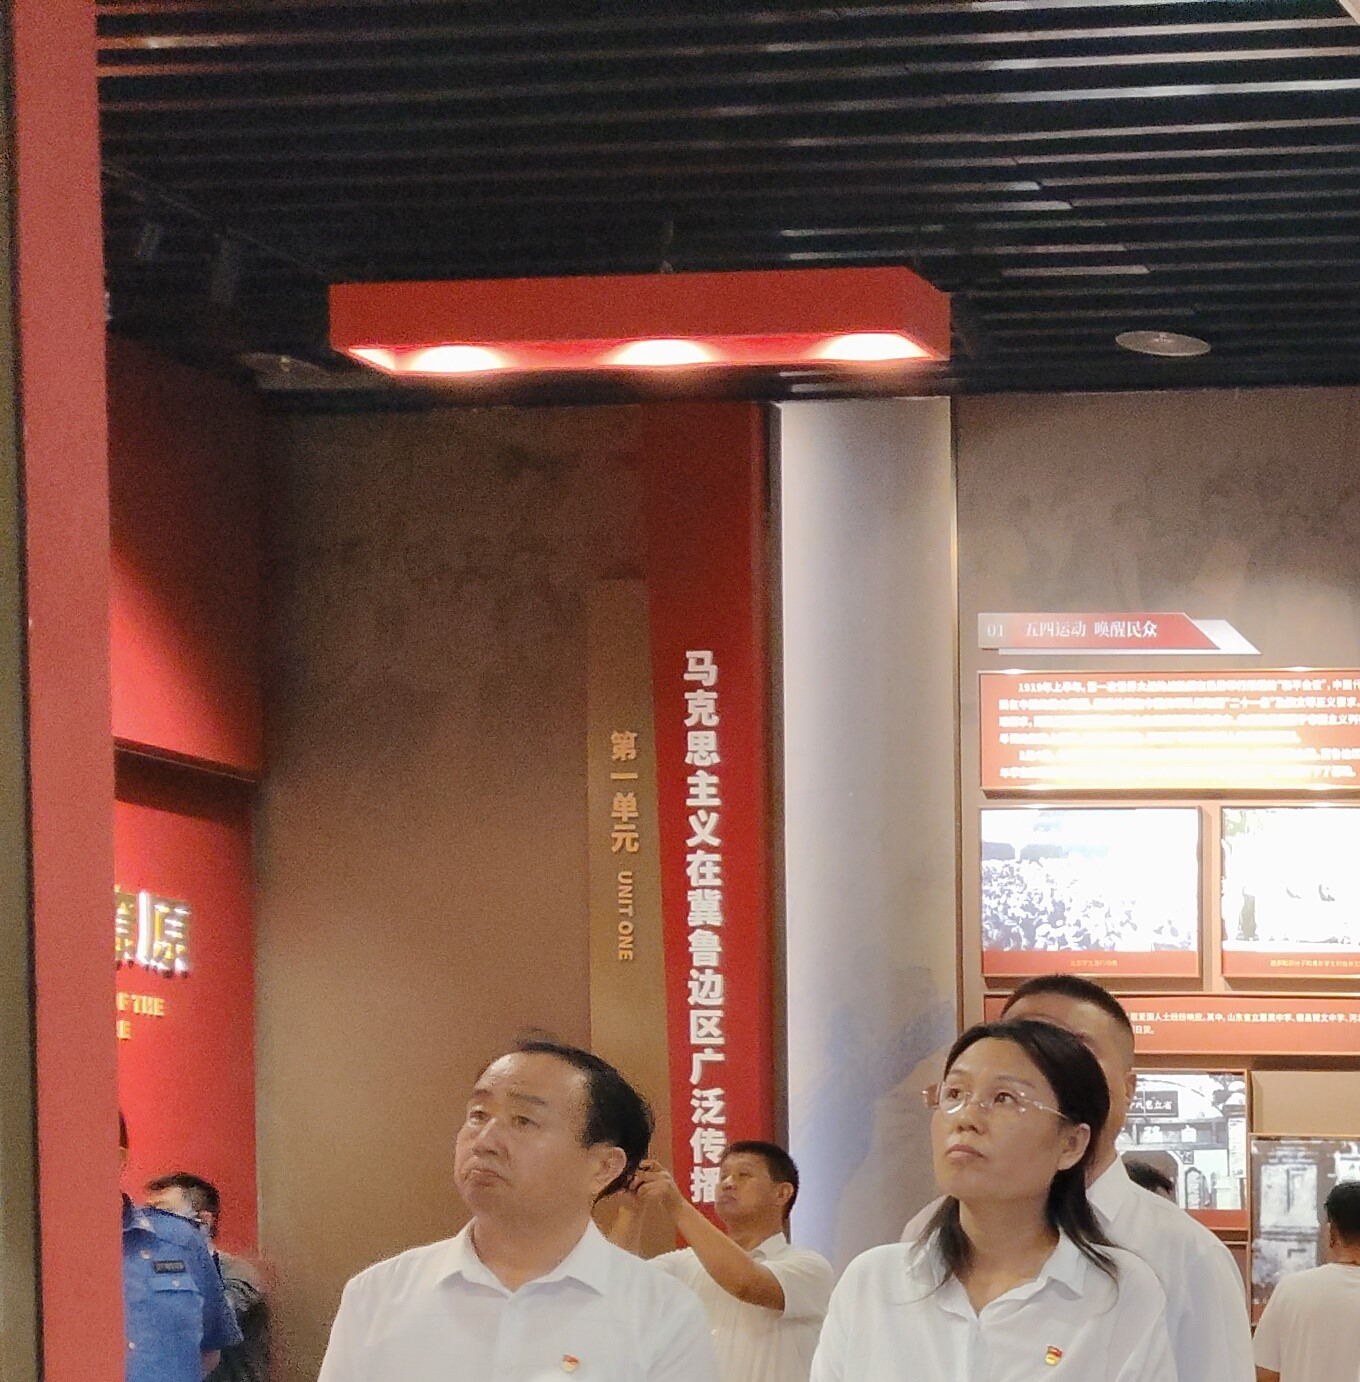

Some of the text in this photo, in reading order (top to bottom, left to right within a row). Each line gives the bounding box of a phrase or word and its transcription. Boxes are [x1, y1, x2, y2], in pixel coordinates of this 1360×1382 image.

[987, 623, 1006, 638] 01
[1026, 620, 1158, 639] 五四运动 唤醒民众
[610, 730, 640, 853] 第一单元
[617, 871, 635, 961] UNIT ONE
[683, 650, 726, 1203] 马克思主义在冀鲁边区广泛传播
